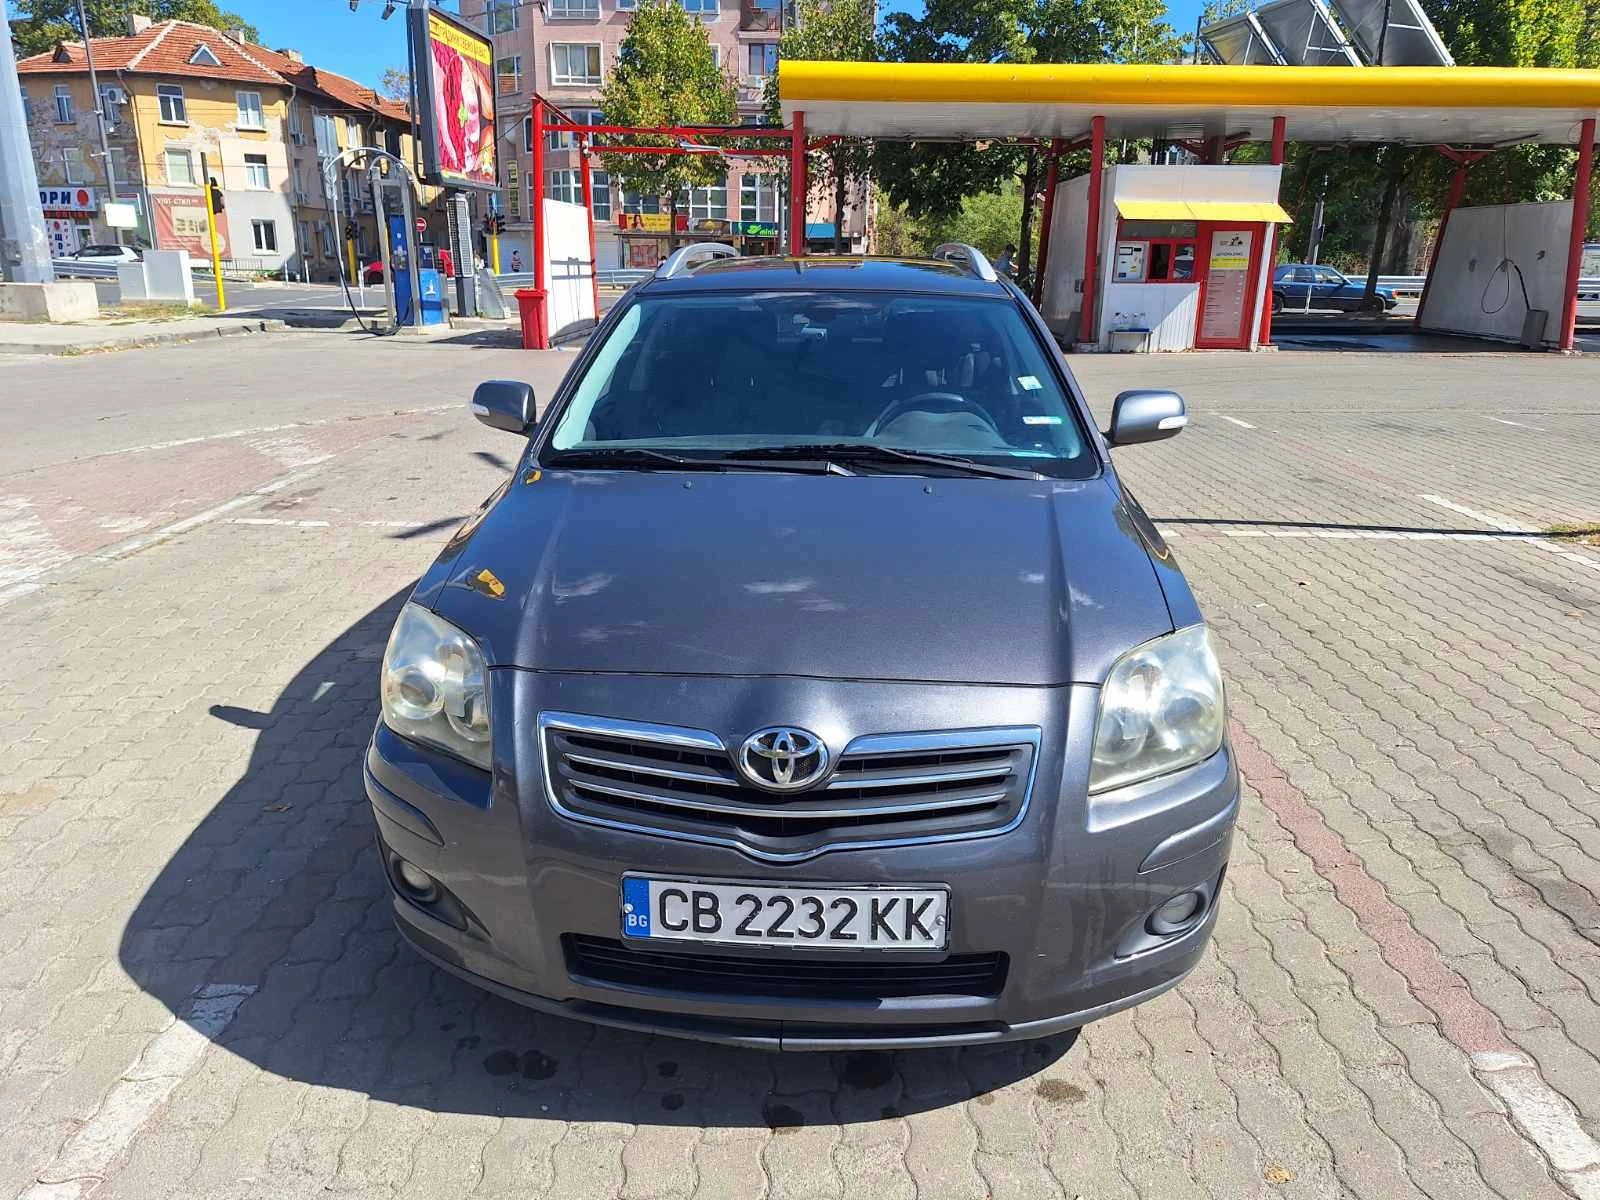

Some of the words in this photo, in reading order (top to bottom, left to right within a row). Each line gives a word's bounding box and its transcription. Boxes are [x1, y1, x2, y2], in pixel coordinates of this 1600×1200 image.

[628, 914, 648, 928] BG
[659, 888, 723, 934] CB
[735, 893, 858, 941] 2232
[870, 897, 935, 942] KK
